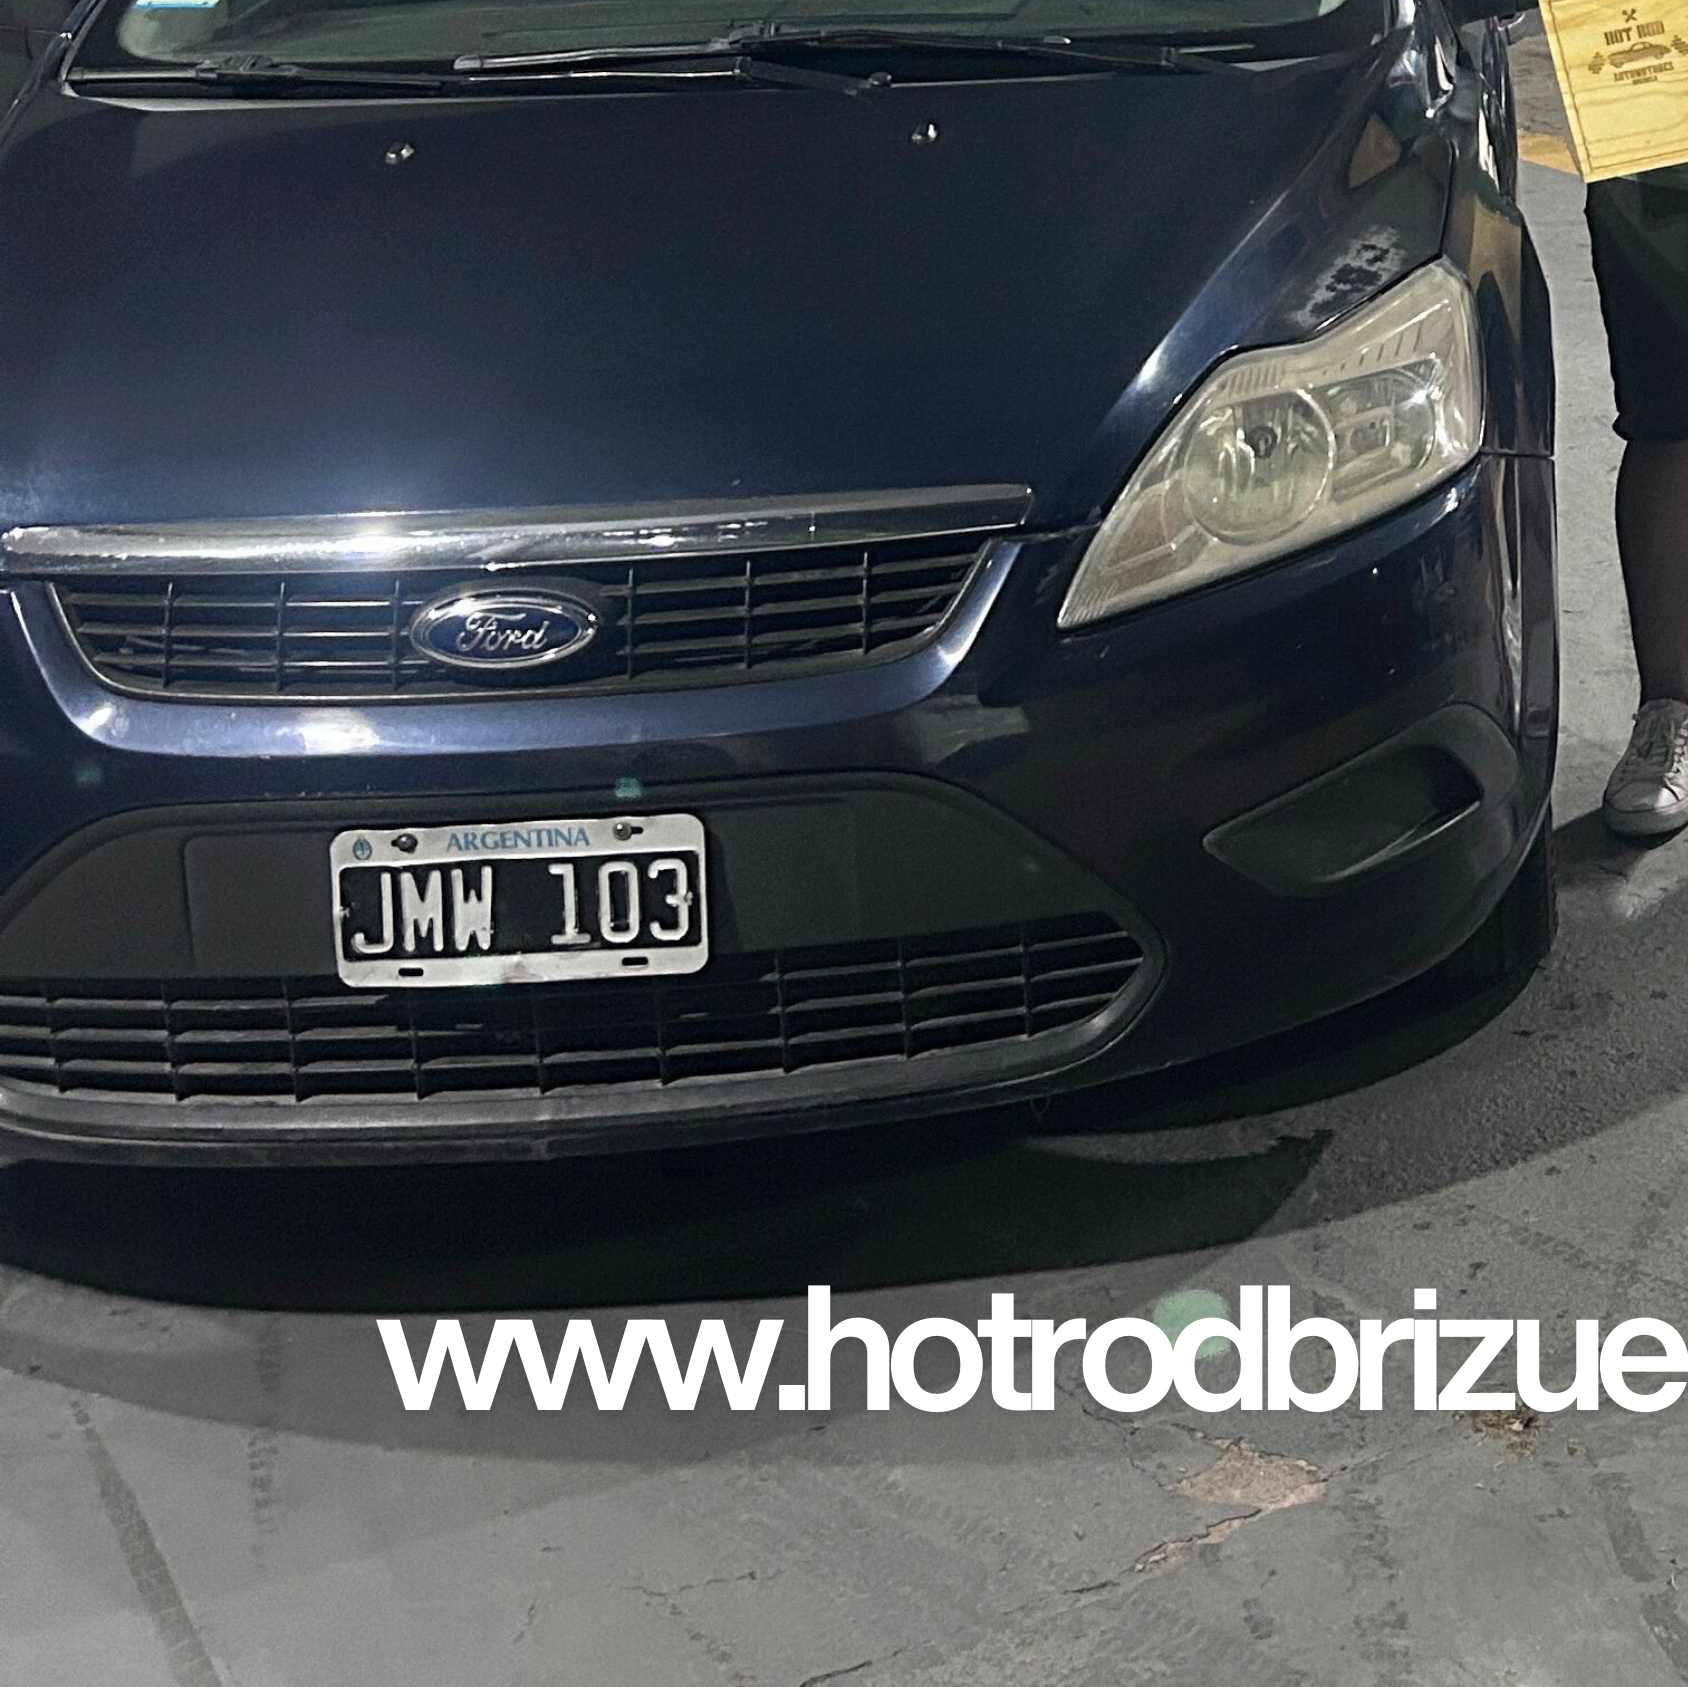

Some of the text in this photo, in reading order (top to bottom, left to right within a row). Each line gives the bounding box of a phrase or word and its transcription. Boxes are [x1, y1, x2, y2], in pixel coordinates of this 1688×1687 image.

[454, 611, 550, 654] Ford
[446, 826, 591, 853] ARGENTINA
[352, 856, 694, 955] JMW 103
